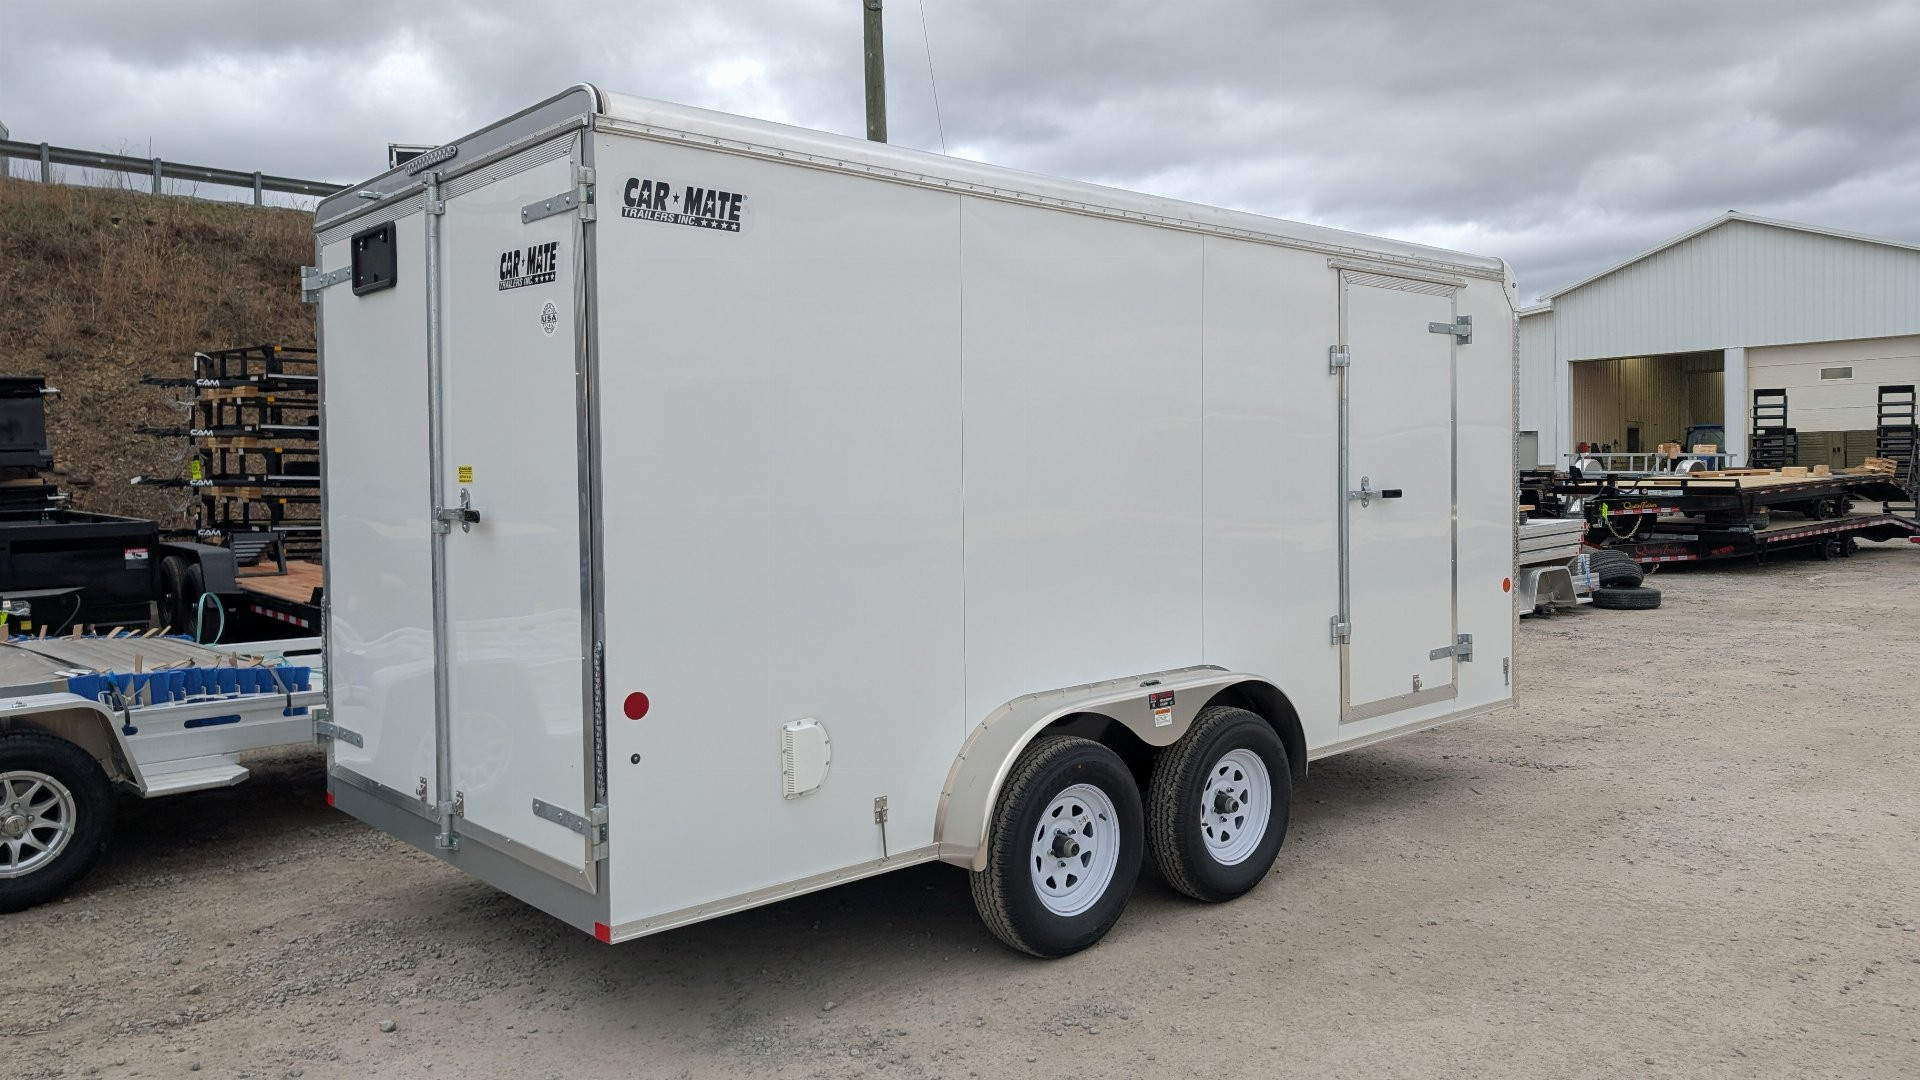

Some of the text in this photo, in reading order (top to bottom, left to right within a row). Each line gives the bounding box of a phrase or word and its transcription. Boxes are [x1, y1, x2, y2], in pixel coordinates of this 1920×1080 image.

[624, 178, 743, 221] CAR MATE
[624, 208, 698, 226] TRAILERS INC.
[499, 241, 557, 280] CAR MATE
[499, 277, 523, 290] TRAILERS
[541, 314, 557, 323] USA
